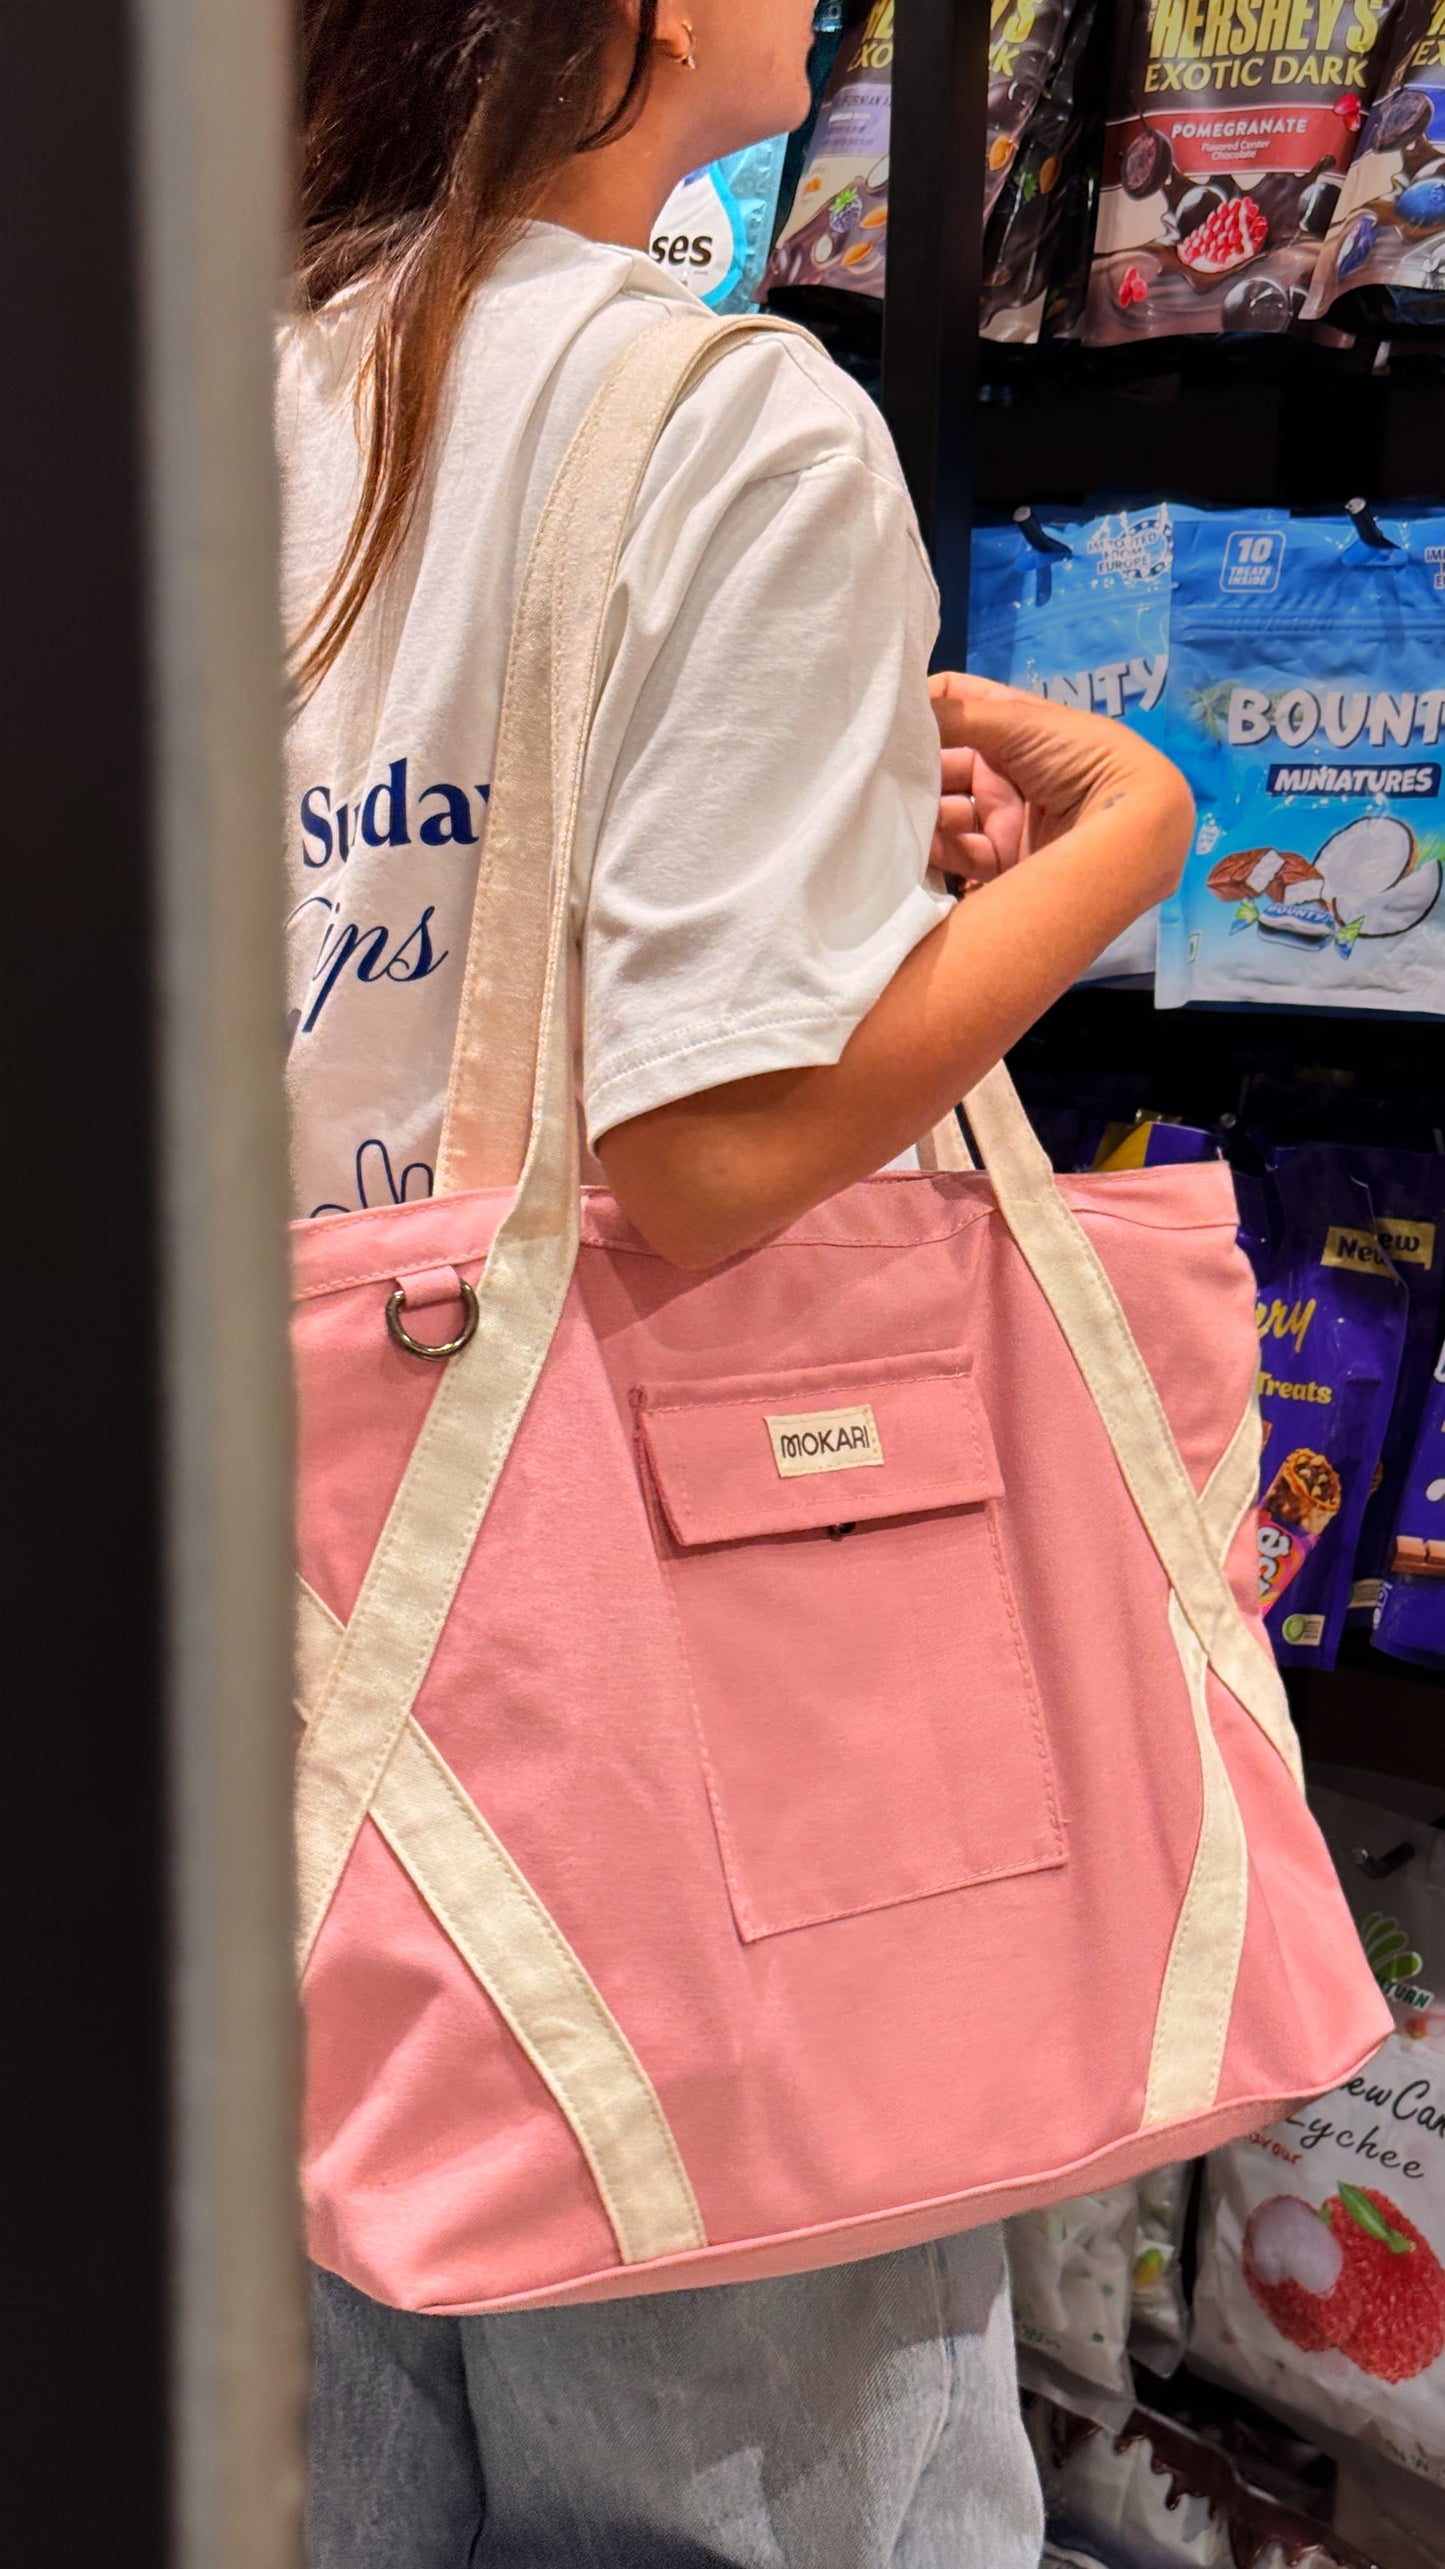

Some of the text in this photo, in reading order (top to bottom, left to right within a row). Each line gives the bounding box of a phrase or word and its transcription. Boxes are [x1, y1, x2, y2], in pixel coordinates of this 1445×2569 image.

[1144, 55, 1368, 94] EXOTIC DARK
[1171, 117, 1307, 139] POMEGRANATE
[1201, 140, 1270, 152] Flavored Center
[1212, 150, 1256, 161] Chocolate
[1238, 537, 1273, 563] 10
[1274, 766, 1434, 793] MINIATURES
[1267, 905, 1325, 923] BOUNTY
[1377, 1232, 1420, 1252] ew
[1257, 1370, 1332, 1405] Treats
[780, 1425, 870, 1458] MOKARI
[1340, 2076, 1392, 2108] ew
[1245, 2130, 1303, 2166] avour
